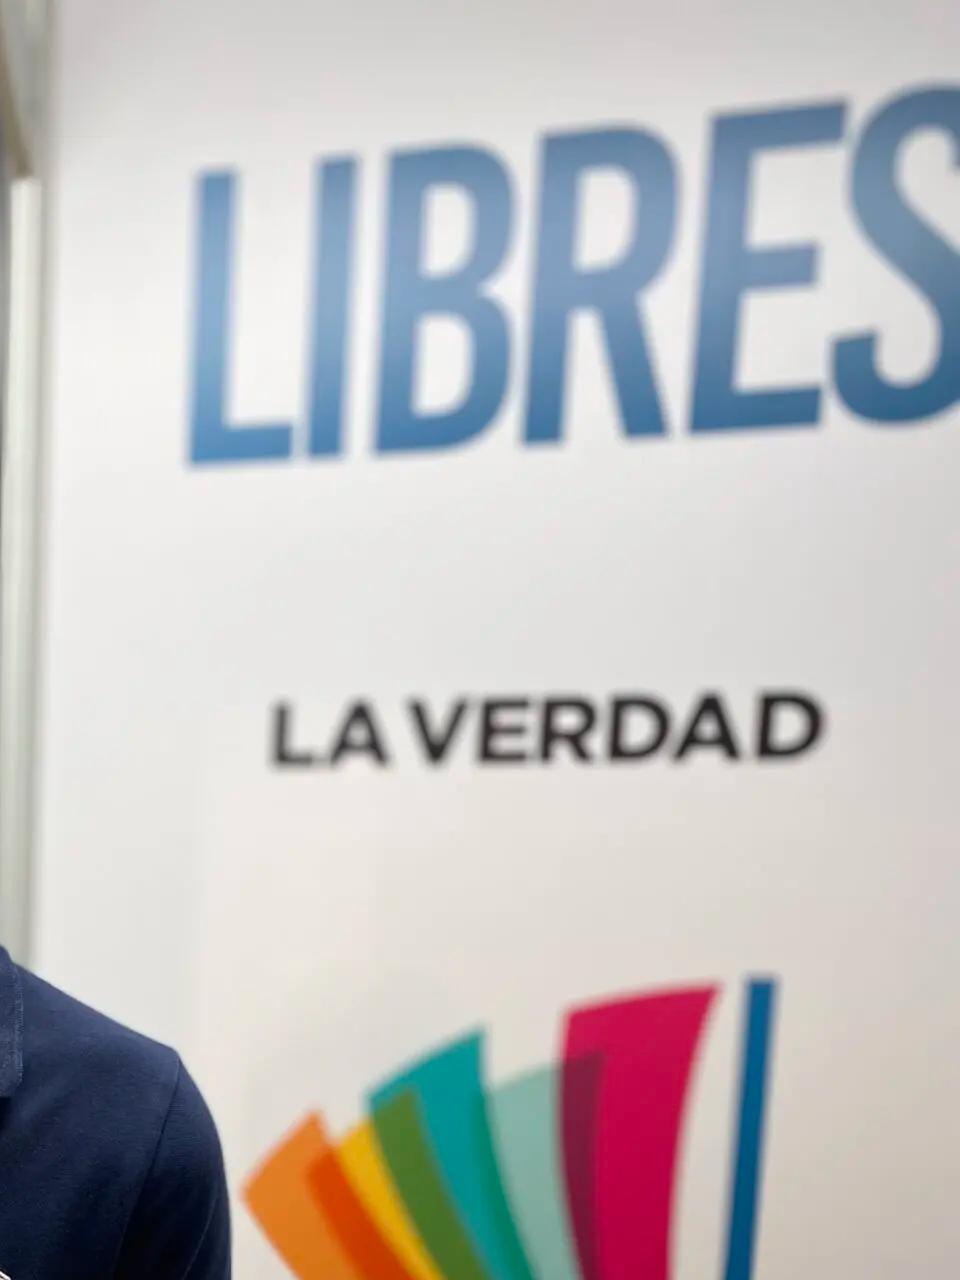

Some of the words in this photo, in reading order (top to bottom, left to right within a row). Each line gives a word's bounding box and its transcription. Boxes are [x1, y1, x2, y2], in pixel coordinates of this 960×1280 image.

[185, 80, 960, 470] LIBRES
[268, 698, 390, 769] LA
[406, 689, 827, 767] VERDAD
